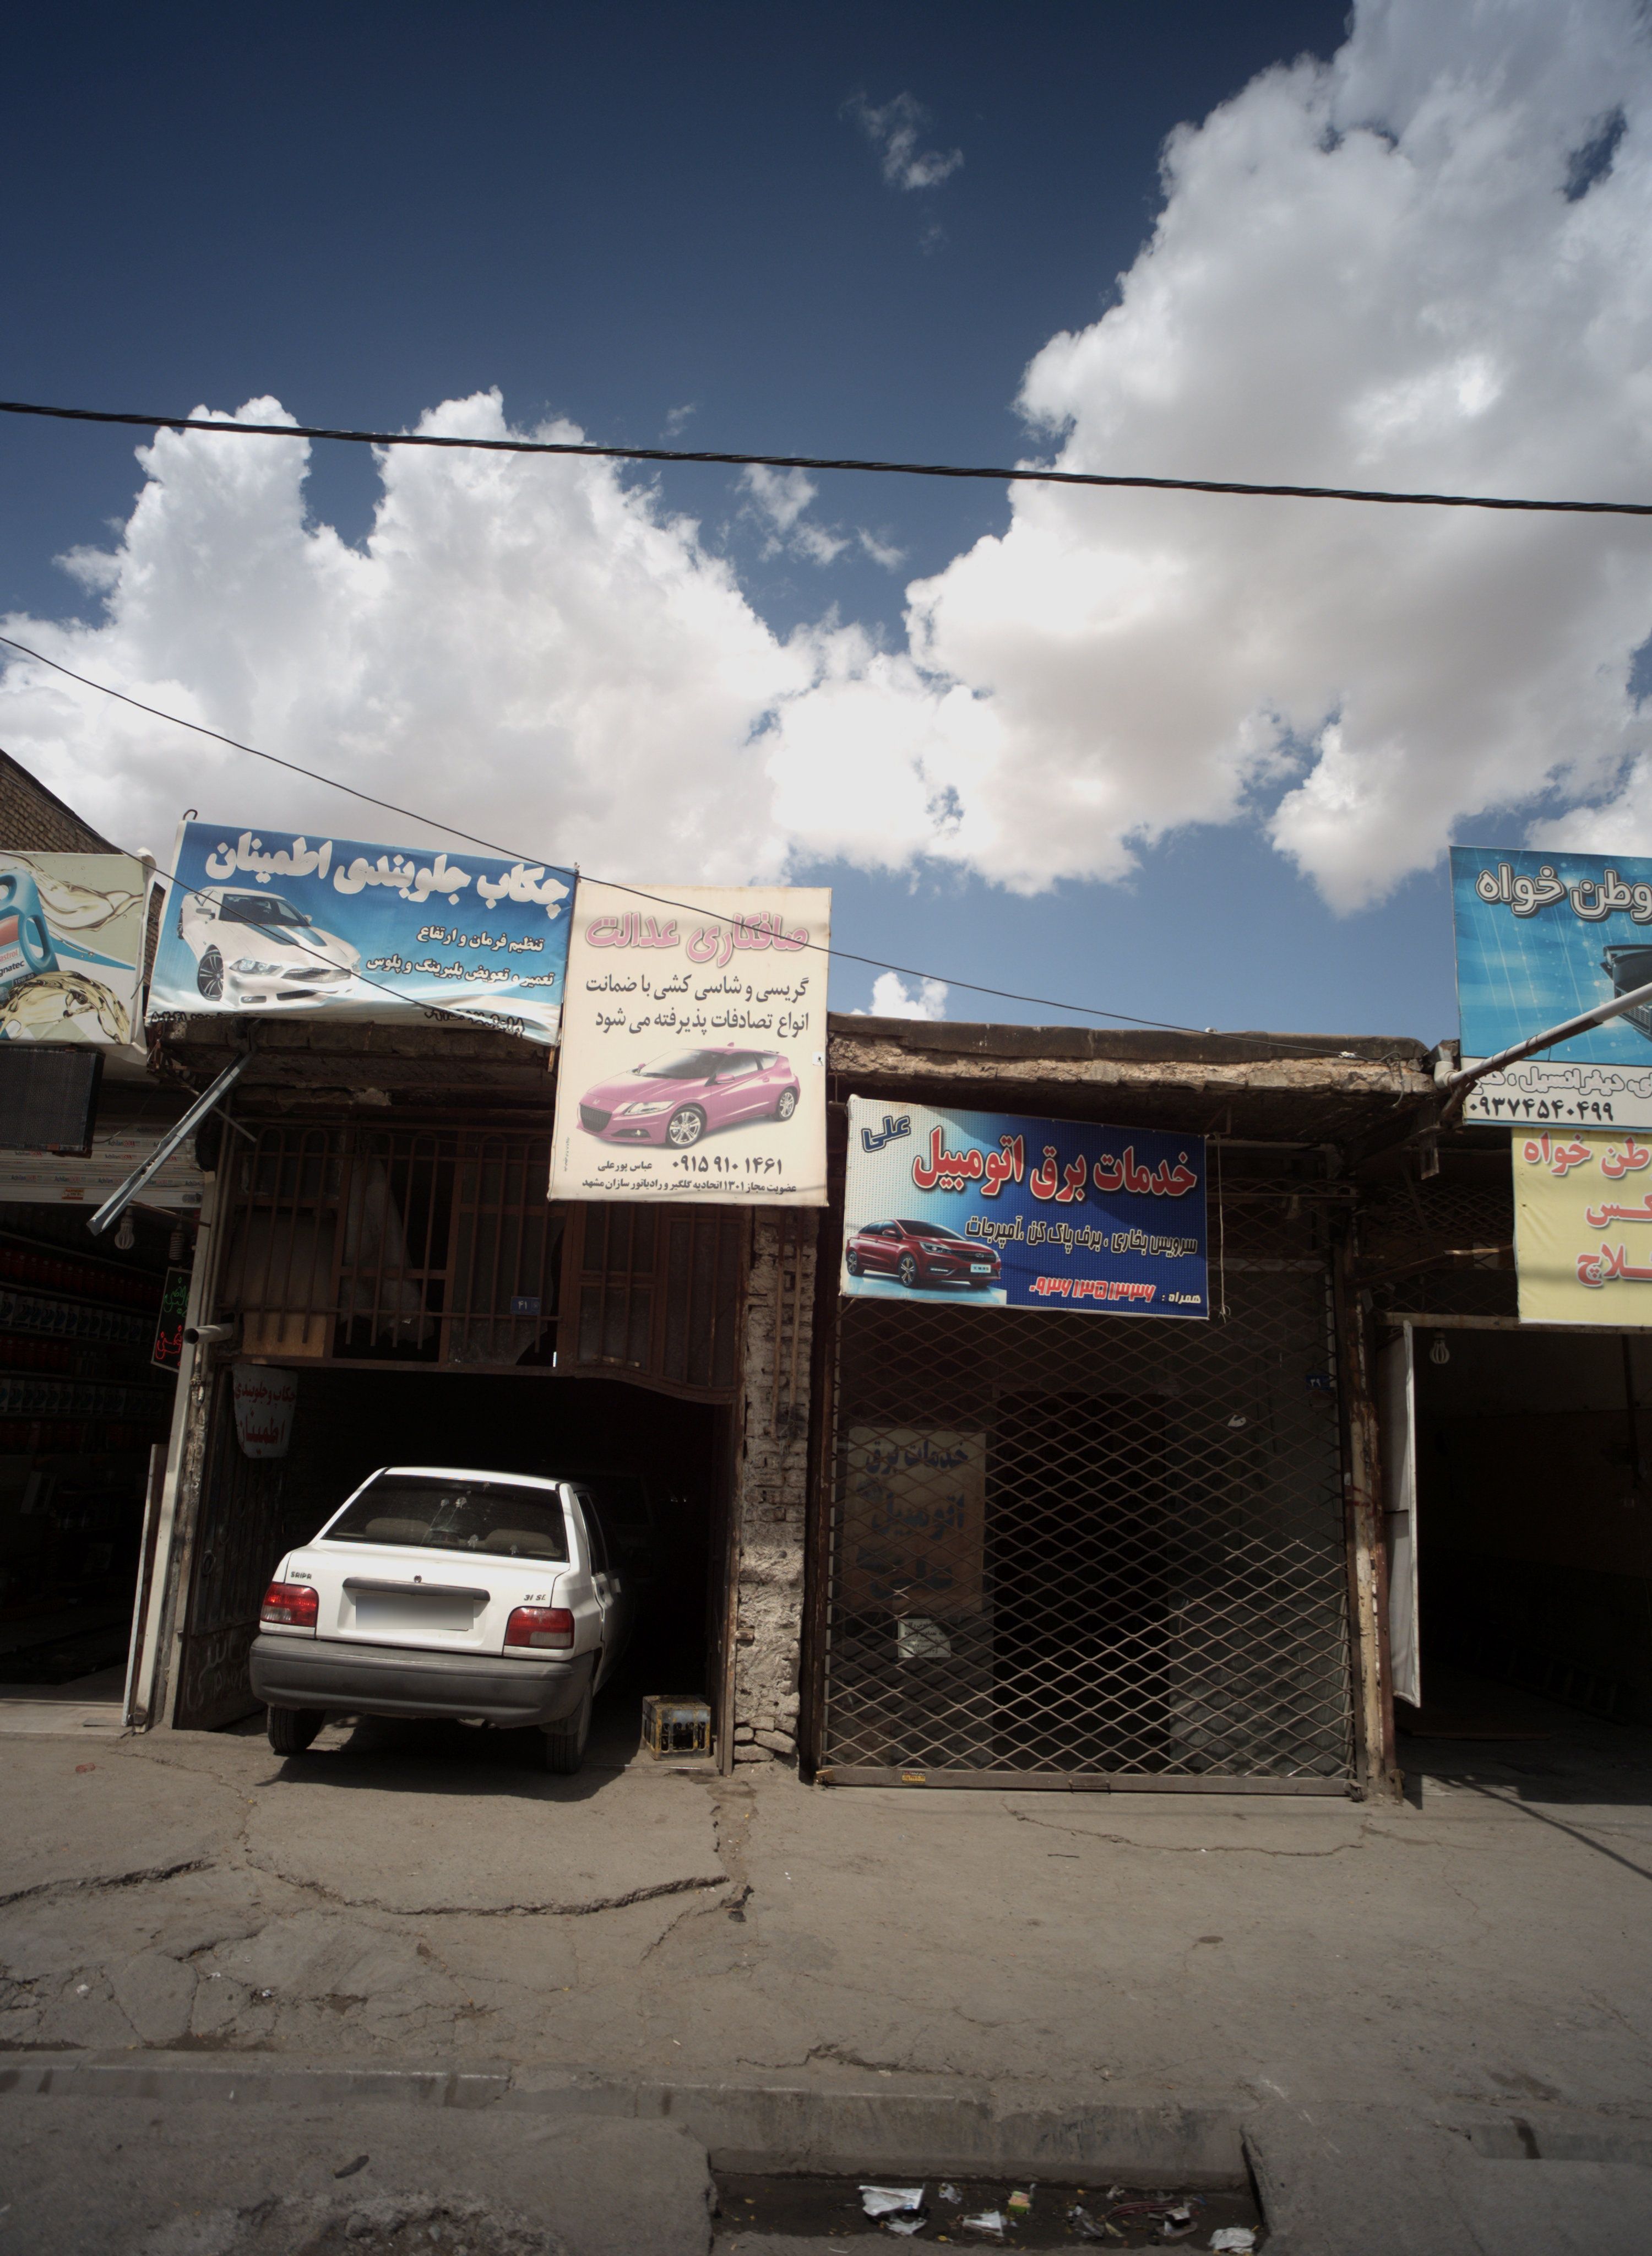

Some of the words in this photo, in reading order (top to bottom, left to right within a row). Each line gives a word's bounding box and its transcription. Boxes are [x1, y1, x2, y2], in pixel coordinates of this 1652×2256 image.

[205, 832, 332, 883] اطمینان
[334, 854, 471, 905] جلوبندی
[1476, 863, 1566, 916] خواه
[417, 925, 458, 945] ارتفاع
[458, 933, 468, 947] و
[469, 932, 507, 951] فرمان
[585, 912, 680, 948] عدالت
[688, 912, 810, 968] صافکاری
[0, 949, 19, 962] astrol
[508, 936, 544, 953] تنظیم
[0, 961, 25, 977] gnatec
[366, 954, 402, 974] پلوس
[403, 962, 413, 974] و
[415, 959, 463, 978] بلبرینگ
[465, 966, 510, 984] تعویض
[519, 973, 556, 988] تعمیر
[586, 974, 637, 993] ضمانت
[641, 974, 651, 997] با
[654, 974, 692, 1000] کشی
[694, 975, 741, 1000] شاسی
[756, 977, 809, 1003] گریسی
[746, 986, 752, 1002] و
[595, 1007, 626, 1033] شود
[629, 1018, 651, 1034] می
[654, 1007, 707, 1035] پذیرفته
[711, 1010, 773, 1029] تصادفات
[777, 1011, 809, 1038] انواع
[1470, 1096, 1613, 1121] ۰۹۳۷۴۵۴۰۴۹۹
[862, 1115, 911, 1152] علی
[672, 1155, 709, 1172] ۰۹۱۵
[714, 1156, 739, 1173] ۹۱۰
[745, 1157, 782, 1175] ۱۴۶۱
[912, 1126, 1024, 1196] اتومبیل
[1524, 1131, 1591, 1176] خواه
[1601, 1136, 1650, 1178] طن
[629, 1160, 653, 1172] عباس
[1030, 1146, 1087, 1202] برق
[1093, 1146, 1197, 1196] خدمات
[582, 1178, 605, 1189] مشهد
[631, 1178, 662, 1190] رادیاتور
[693, 1180, 722, 1191] اتحادیه
[746, 1181, 765, 1193] مجاز
[767, 1183, 797, 1195] عضویت
[1027, 1221, 1046, 1245] کن
[1047, 1222, 1073, 1254] پاک
[1074, 1225, 1102, 1252] برف
[1111, 1229, 1148, 1256] بخاری
[1150, 1235, 1198, 1257] سرویس
[1577, 1243, 1652, 1287] لاچ
[1169, 1292, 1202, 1304] همراه
[905, 1439, 969, 1468] خدمات
[872, 1492, 965, 1541] اتومبیل
[291, 1571, 312, 1580] SAIPA
